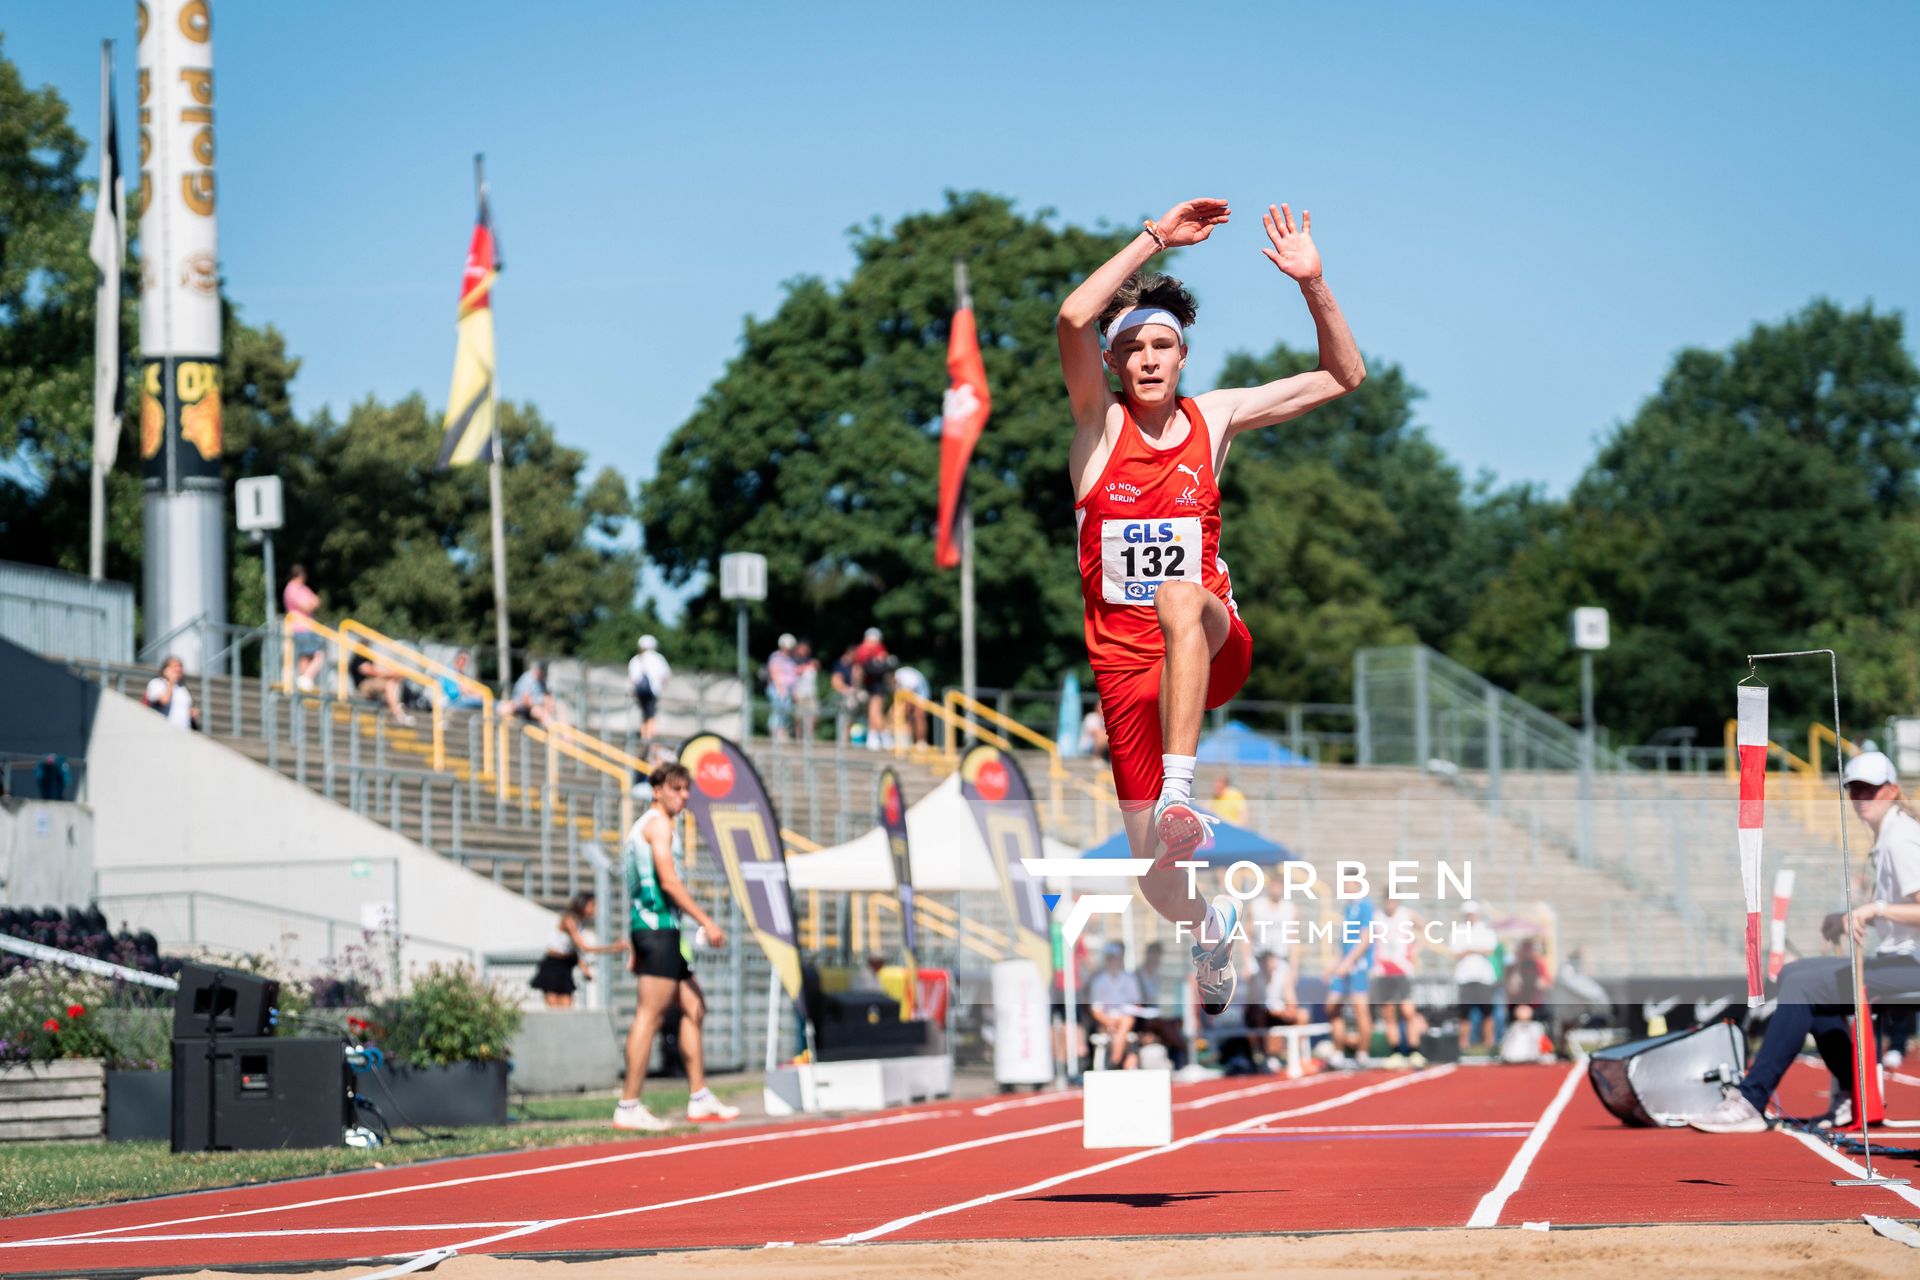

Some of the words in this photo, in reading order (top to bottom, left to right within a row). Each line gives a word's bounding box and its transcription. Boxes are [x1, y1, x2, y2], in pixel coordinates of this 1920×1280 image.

[179, 68, 213, 216] Gold
[1105, 483, 1116, 493] LG
[1118, 483, 1142, 496] NORD
[1109, 494, 1136, 503] BERLIN
[1120, 545, 1185, 577] 132
